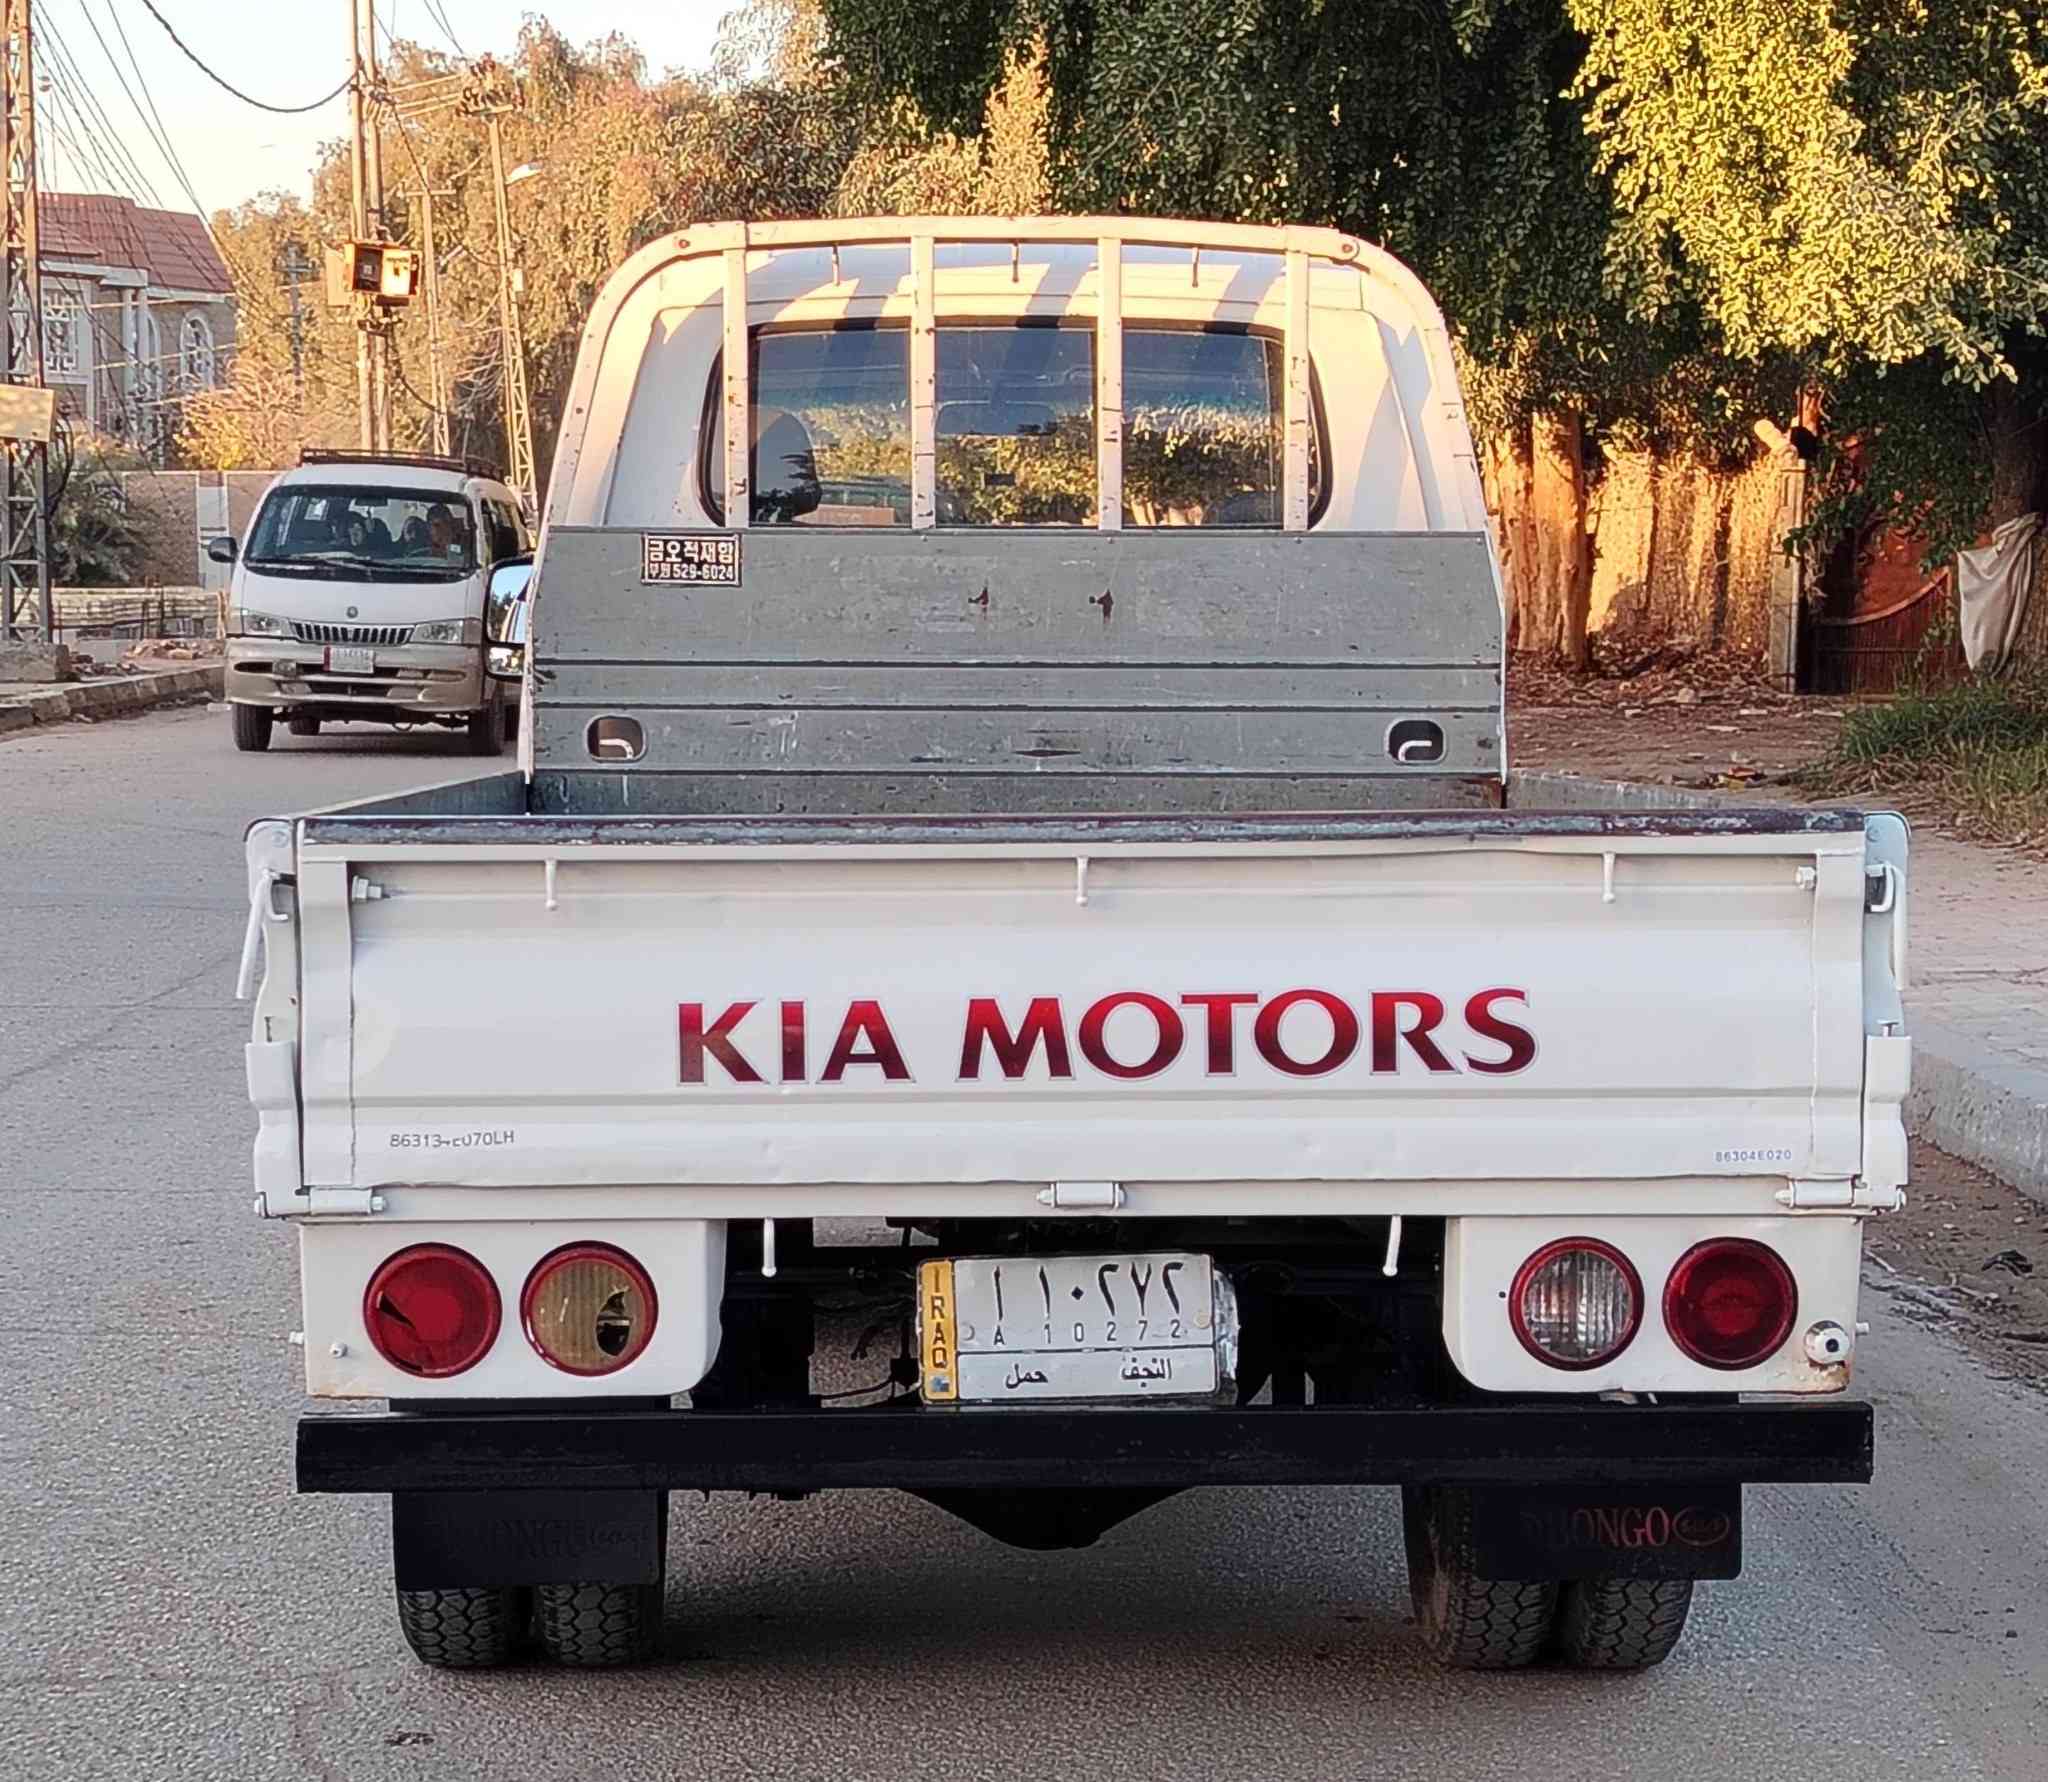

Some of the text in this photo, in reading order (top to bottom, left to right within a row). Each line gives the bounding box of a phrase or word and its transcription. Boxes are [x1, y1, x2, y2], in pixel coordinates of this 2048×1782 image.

[677, 988, 1539, 1084] KIA MOTORS
[931, 1265, 948, 1370] IRAQ
[1005, 1357, 1172, 1390] النجف حمل
